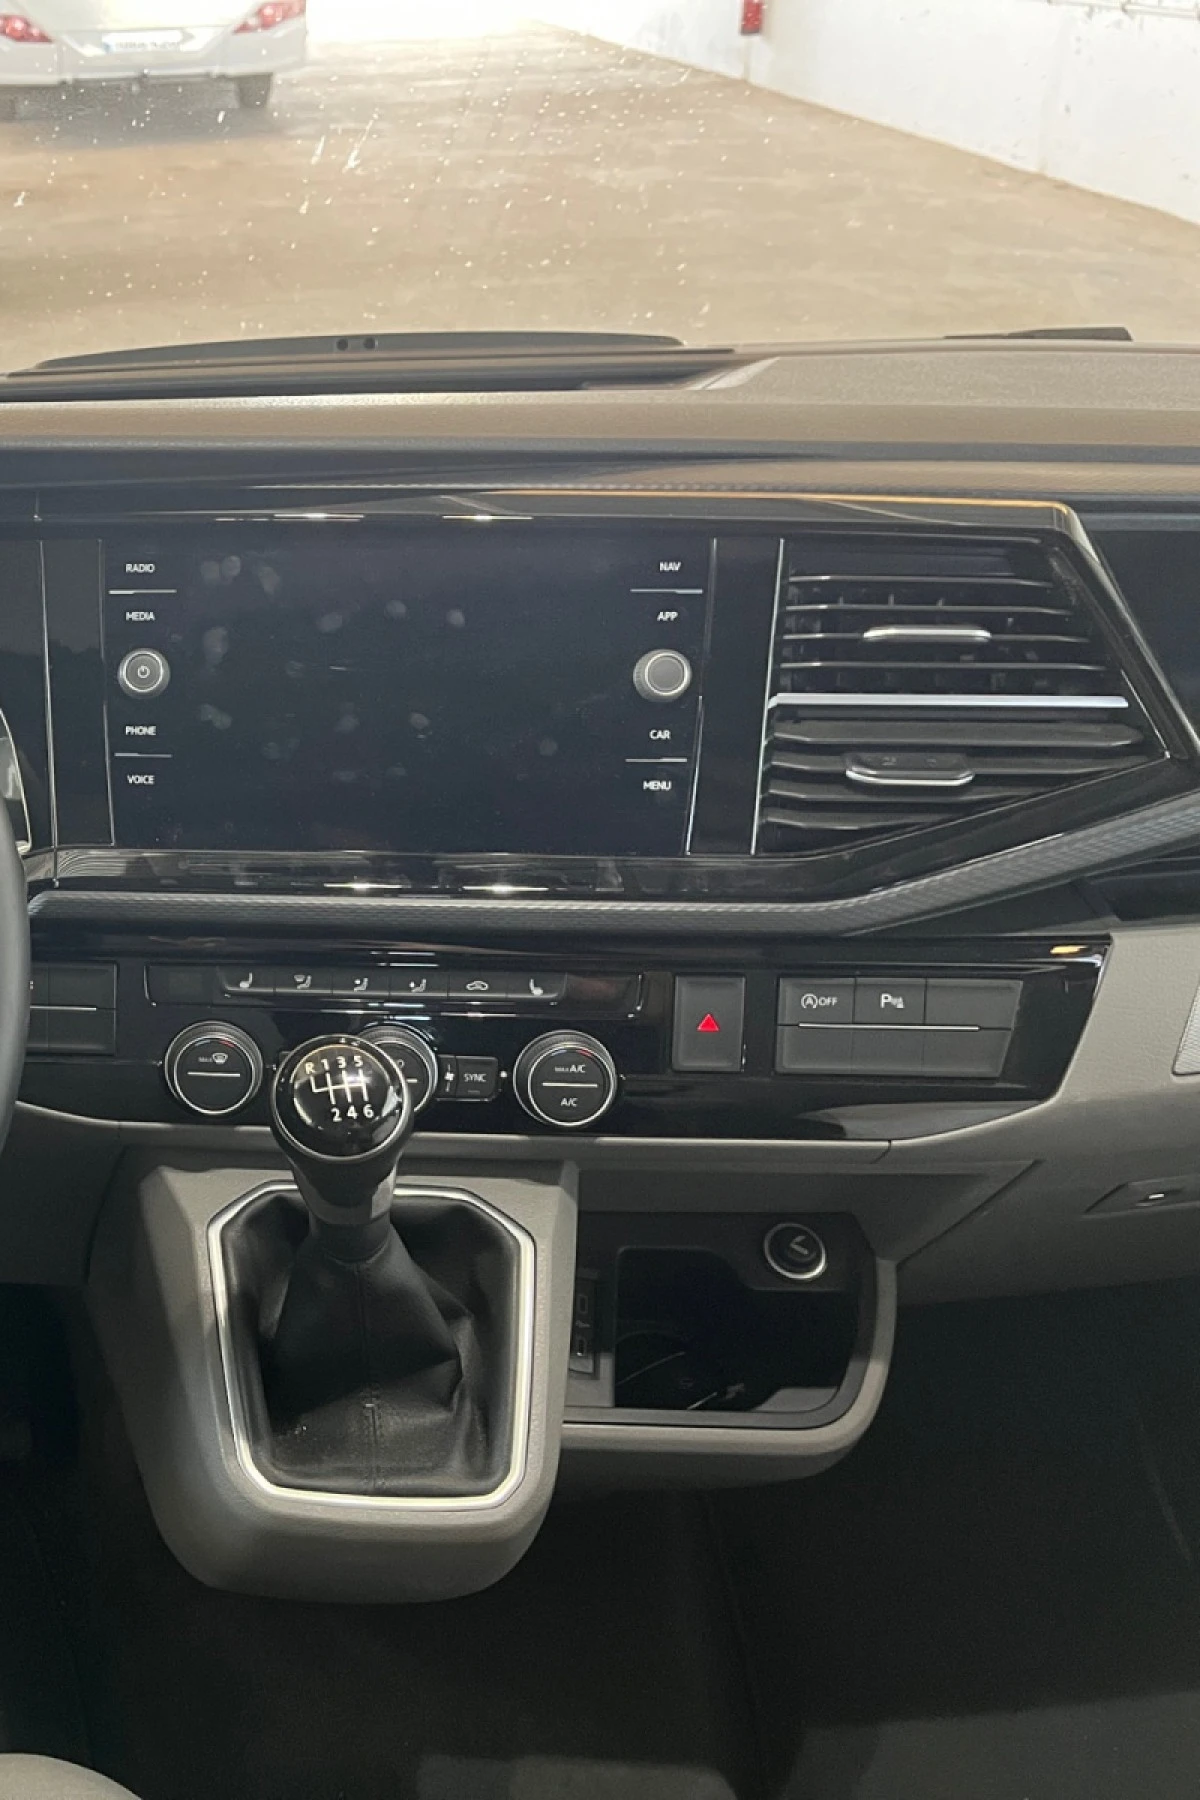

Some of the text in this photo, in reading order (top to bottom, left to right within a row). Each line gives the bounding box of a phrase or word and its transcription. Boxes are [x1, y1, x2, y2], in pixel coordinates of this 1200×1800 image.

[125, 563, 155, 574] RADIO
[659, 561, 681, 572] NAV
[125, 611, 155, 622] MEDIA
[657, 611, 678, 622] APP
[125, 726, 157, 737] PHONE
[650, 730, 671, 740] CAR
[127, 775, 155, 785] VOICE
[643, 780, 671, 791] MENU
[819, 996, 838, 1006] OFF
[305, 1055, 363, 1074] R 1 3 5
[464, 1073, 486, 1083] SYNC
[560, 1097, 578, 1107] A/C
[331, 1103, 375, 1123] 2 4 6
